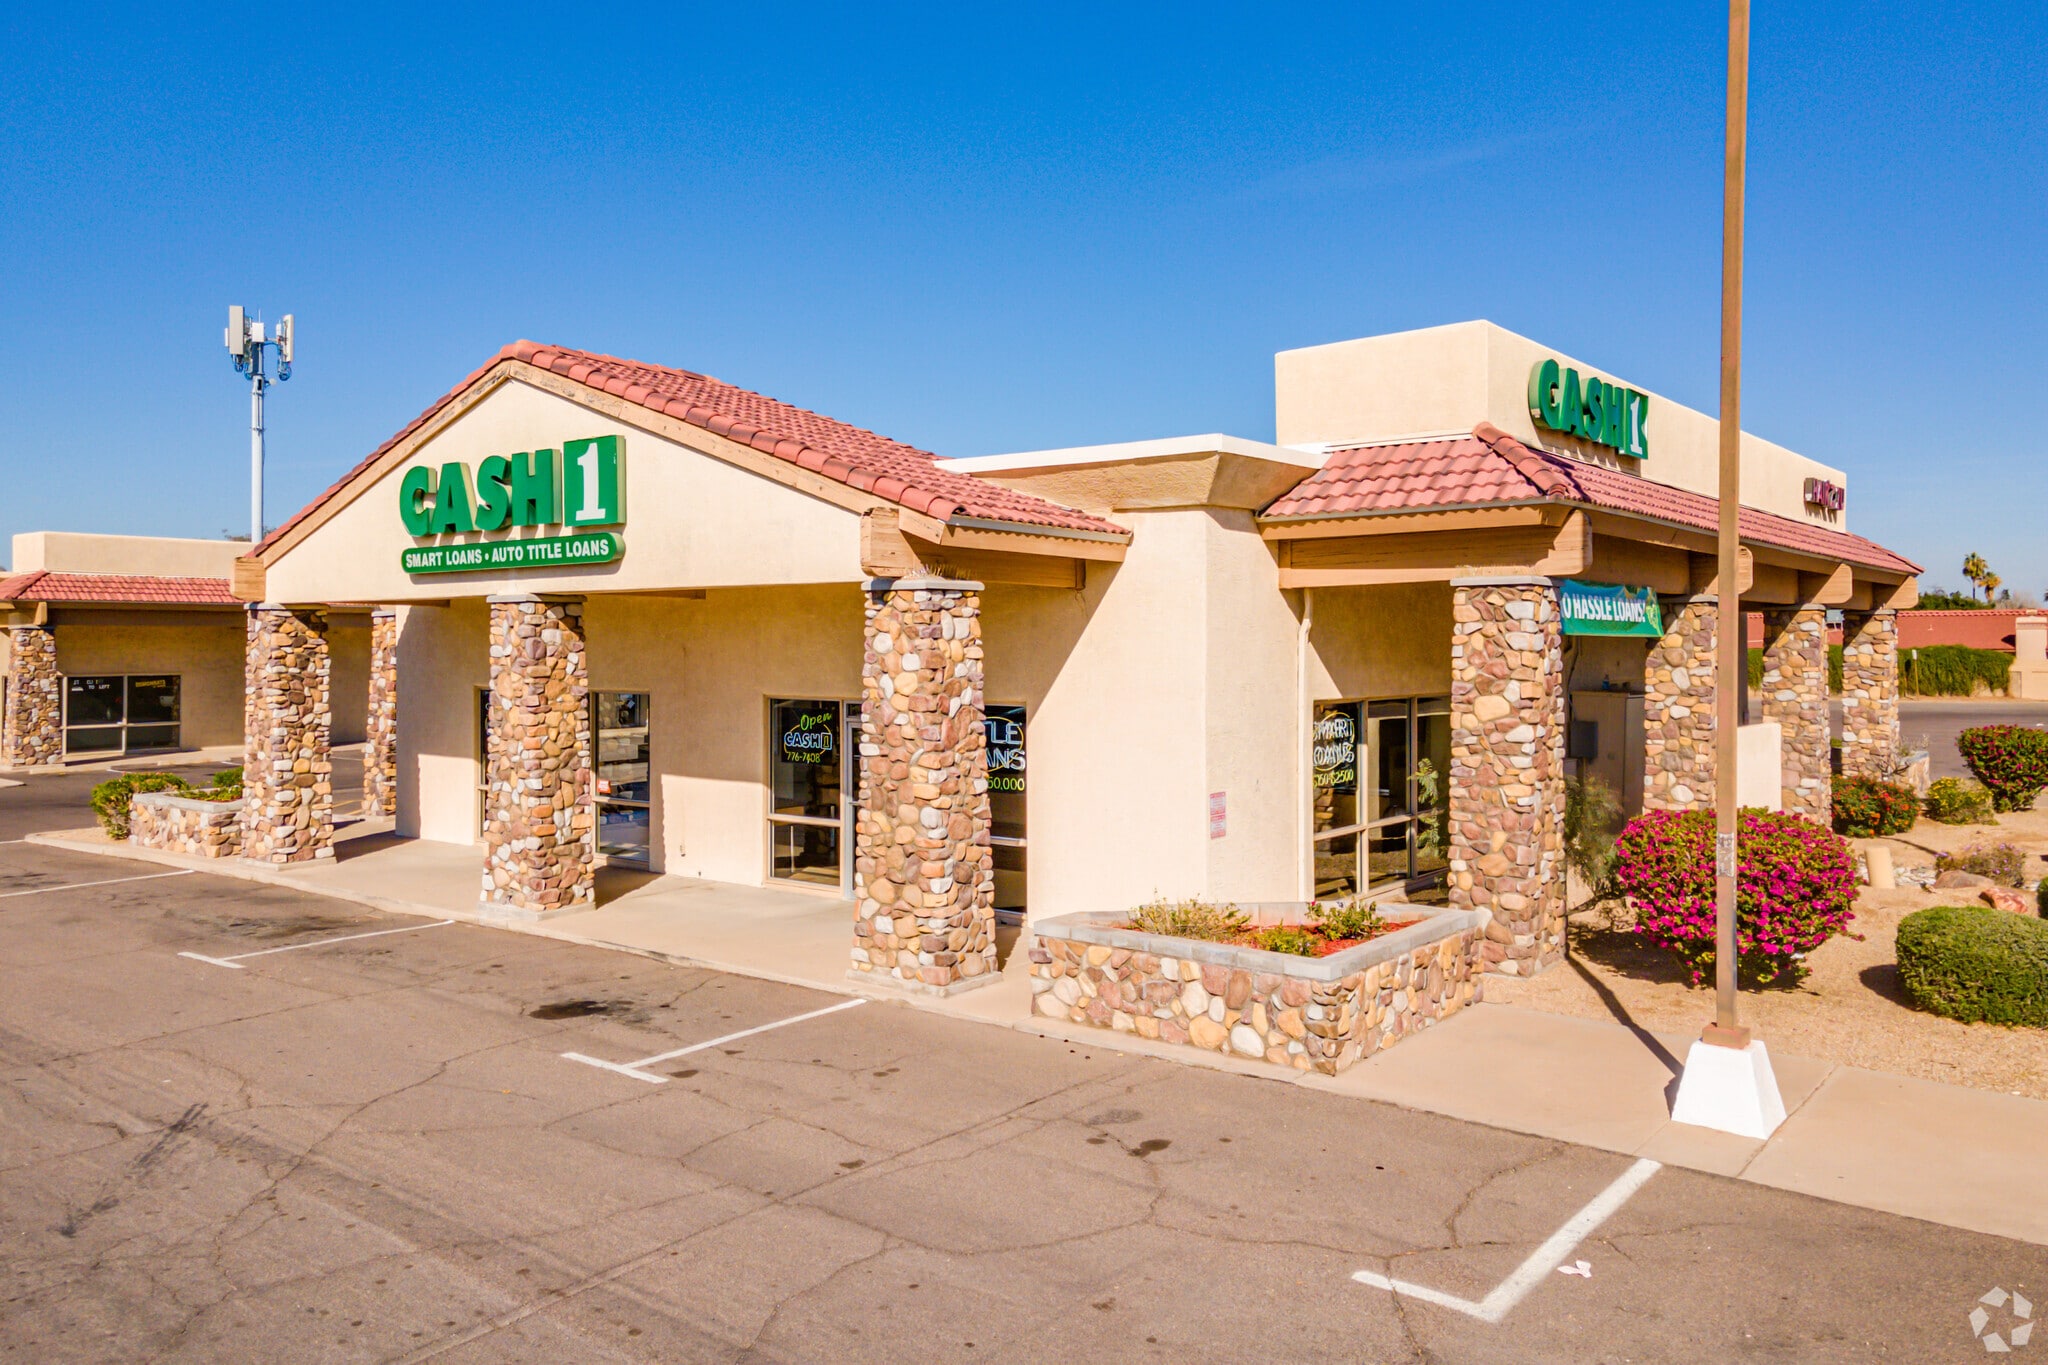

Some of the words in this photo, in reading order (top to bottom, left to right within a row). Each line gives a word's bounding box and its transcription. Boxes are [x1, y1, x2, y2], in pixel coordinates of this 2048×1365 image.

[1530, 358, 1625, 447] CASH
[400, 449, 557, 537] CASH
[405, 551, 442, 568] SMART
[446, 549, 482, 566] LOANS
[491, 546, 524, 563] AUTO
[527, 543, 562, 560] TITLE
[566, 539, 609, 557] LOANS
[1562, 592, 1572, 619] O
[1572, 594, 1612, 621] HASSLE
[1612, 597, 1646, 623] LOANS!
[800, 711, 832, 731] Open
[984, 720, 1022, 745] TLE
[784, 731, 821, 749] CASH
[986, 748, 1025, 771] ANS
[1313, 742, 1354, 767] OANS
[988, 776, 1025, 791] 50,000
